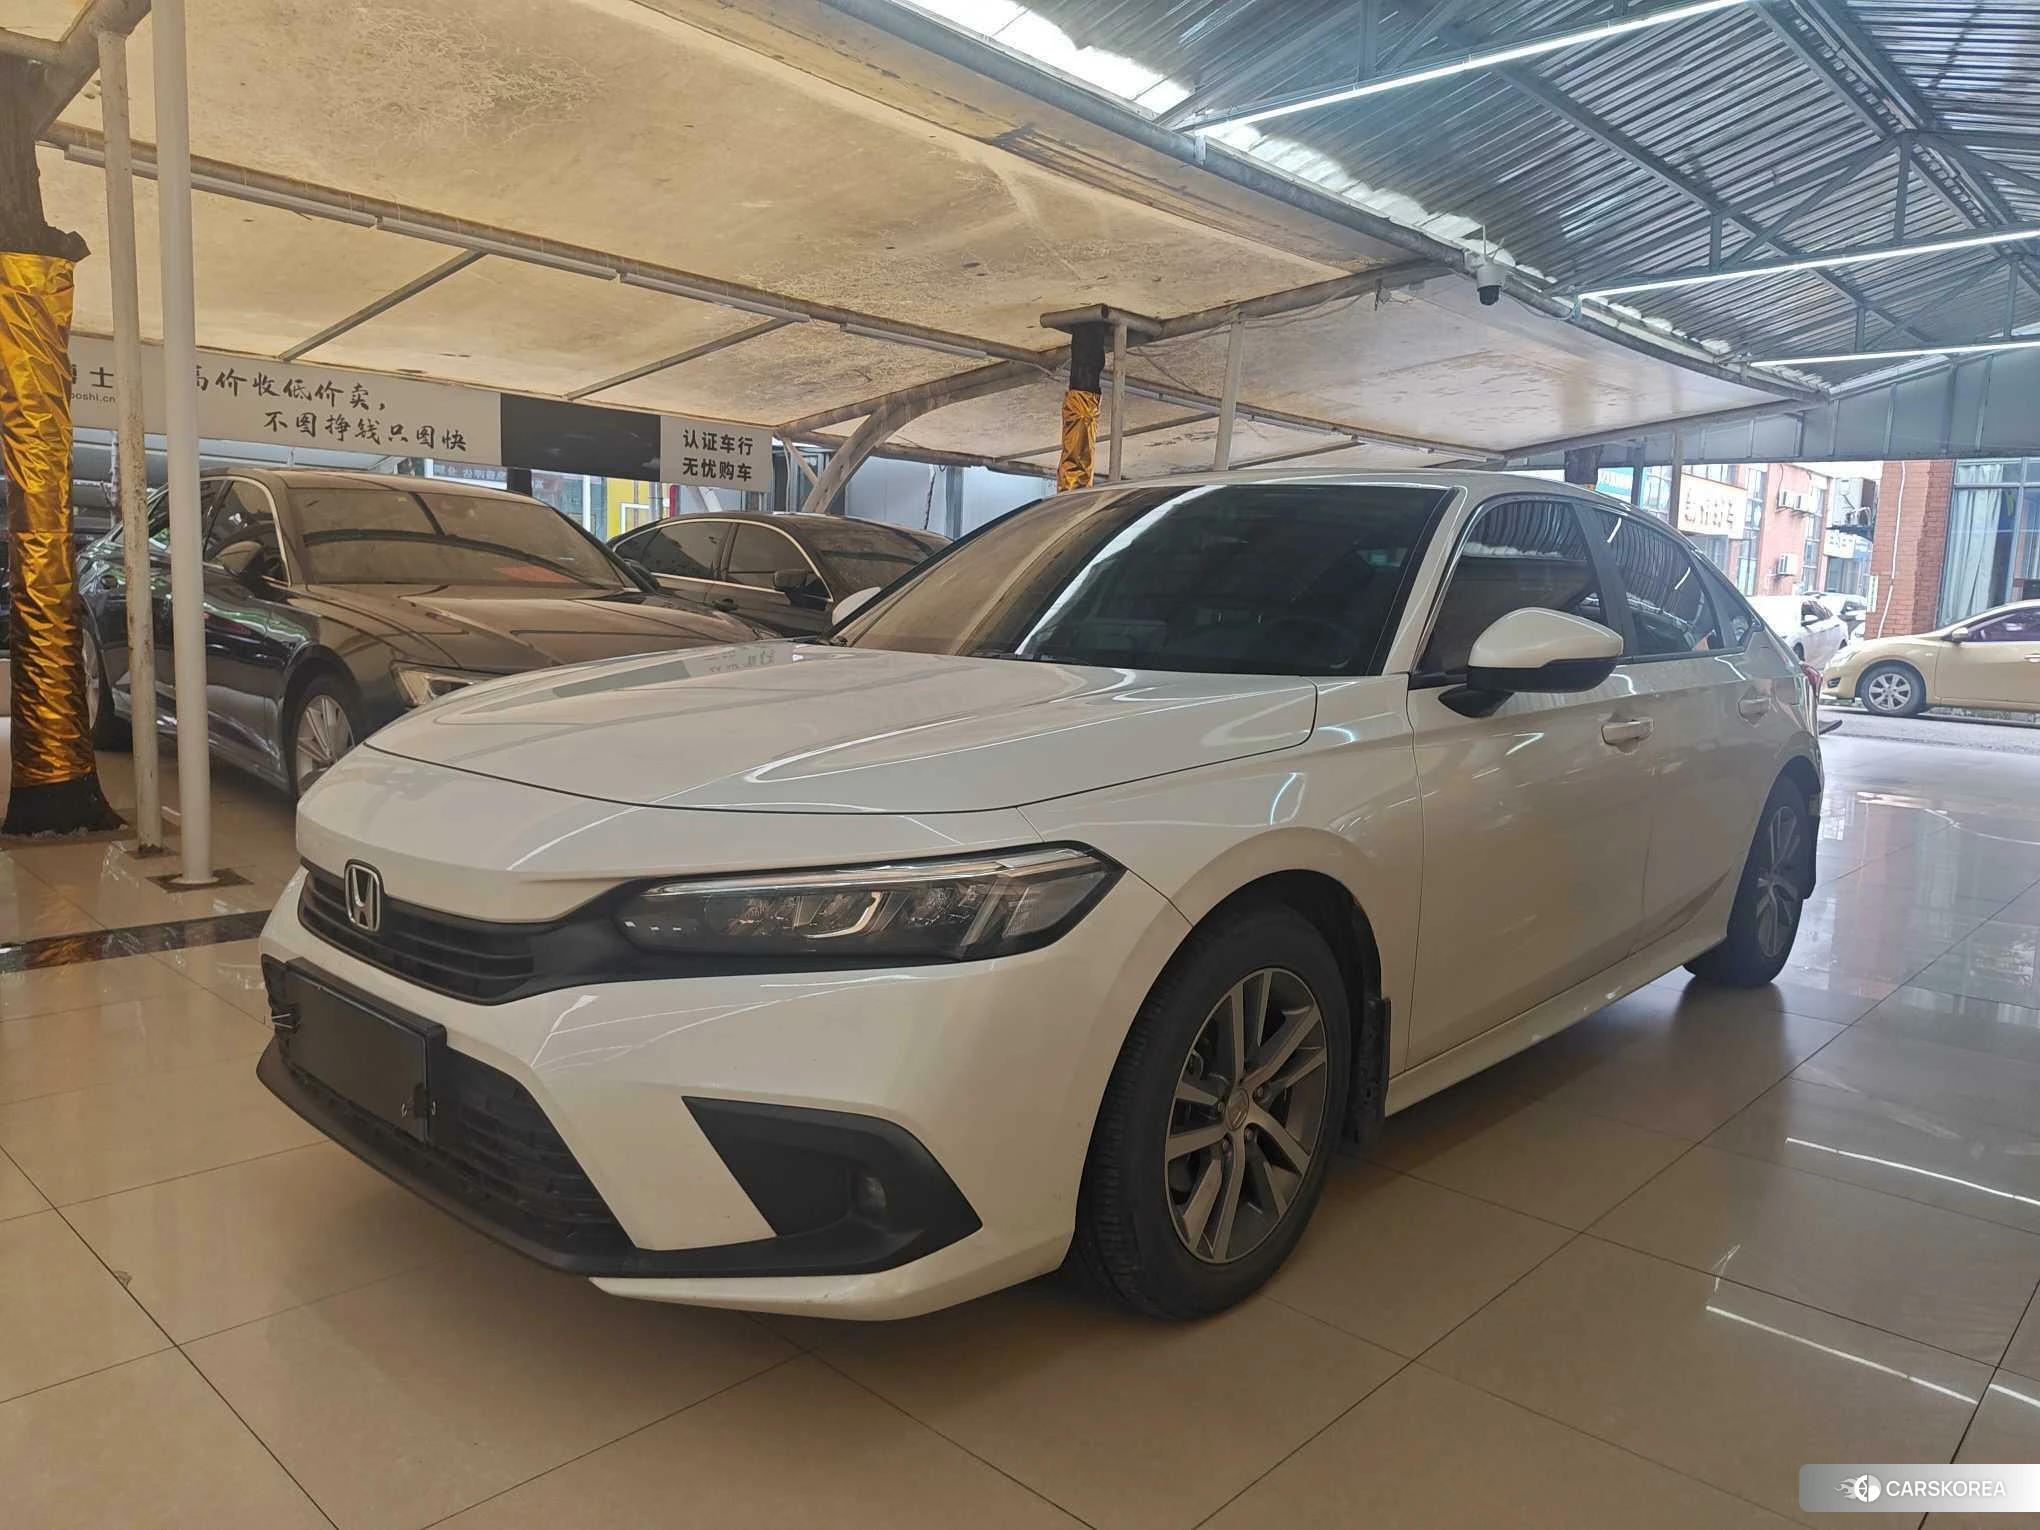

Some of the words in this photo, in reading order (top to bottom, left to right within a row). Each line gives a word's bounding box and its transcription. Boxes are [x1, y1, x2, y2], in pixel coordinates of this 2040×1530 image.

[72, 364, 114, 388] 士
[264, 411, 466, 451] 不图挣钱只图快
[683, 429, 753, 456] 认证车行
[683, 457, 752, 482] 无忧购车
